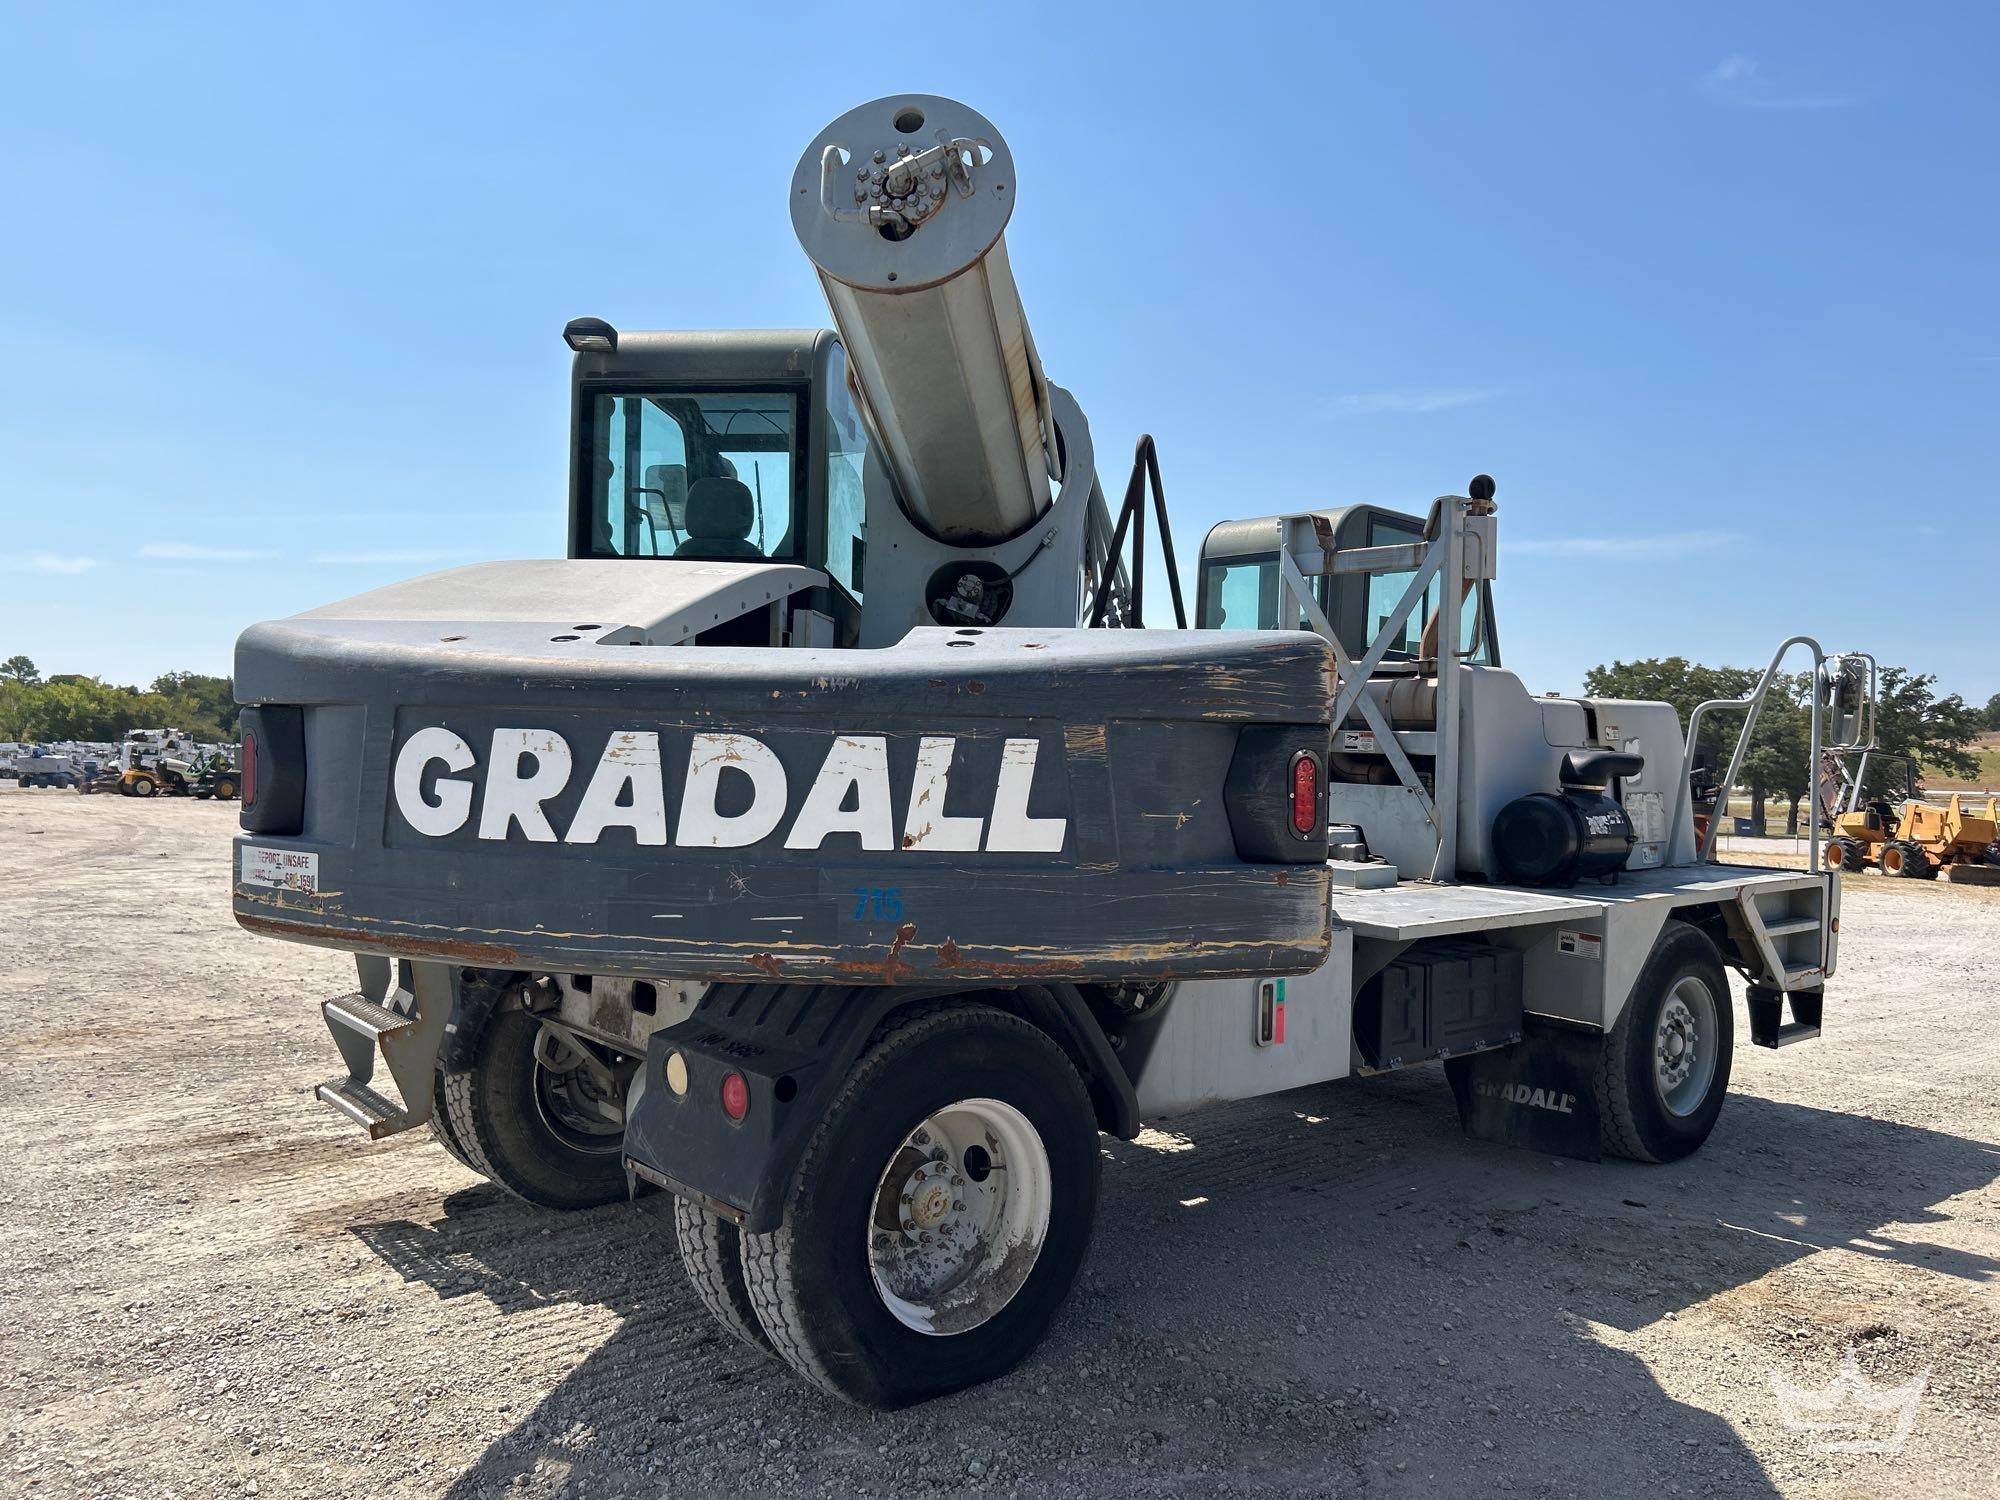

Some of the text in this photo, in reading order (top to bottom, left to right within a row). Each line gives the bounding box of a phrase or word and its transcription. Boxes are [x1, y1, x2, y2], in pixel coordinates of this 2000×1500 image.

[394, 726, 1068, 853] GRADALL
[283, 853, 310, 869] UNSAFE
[853, 887, 905, 921] 715
[1474, 1080, 1572, 1113] GRADALL
